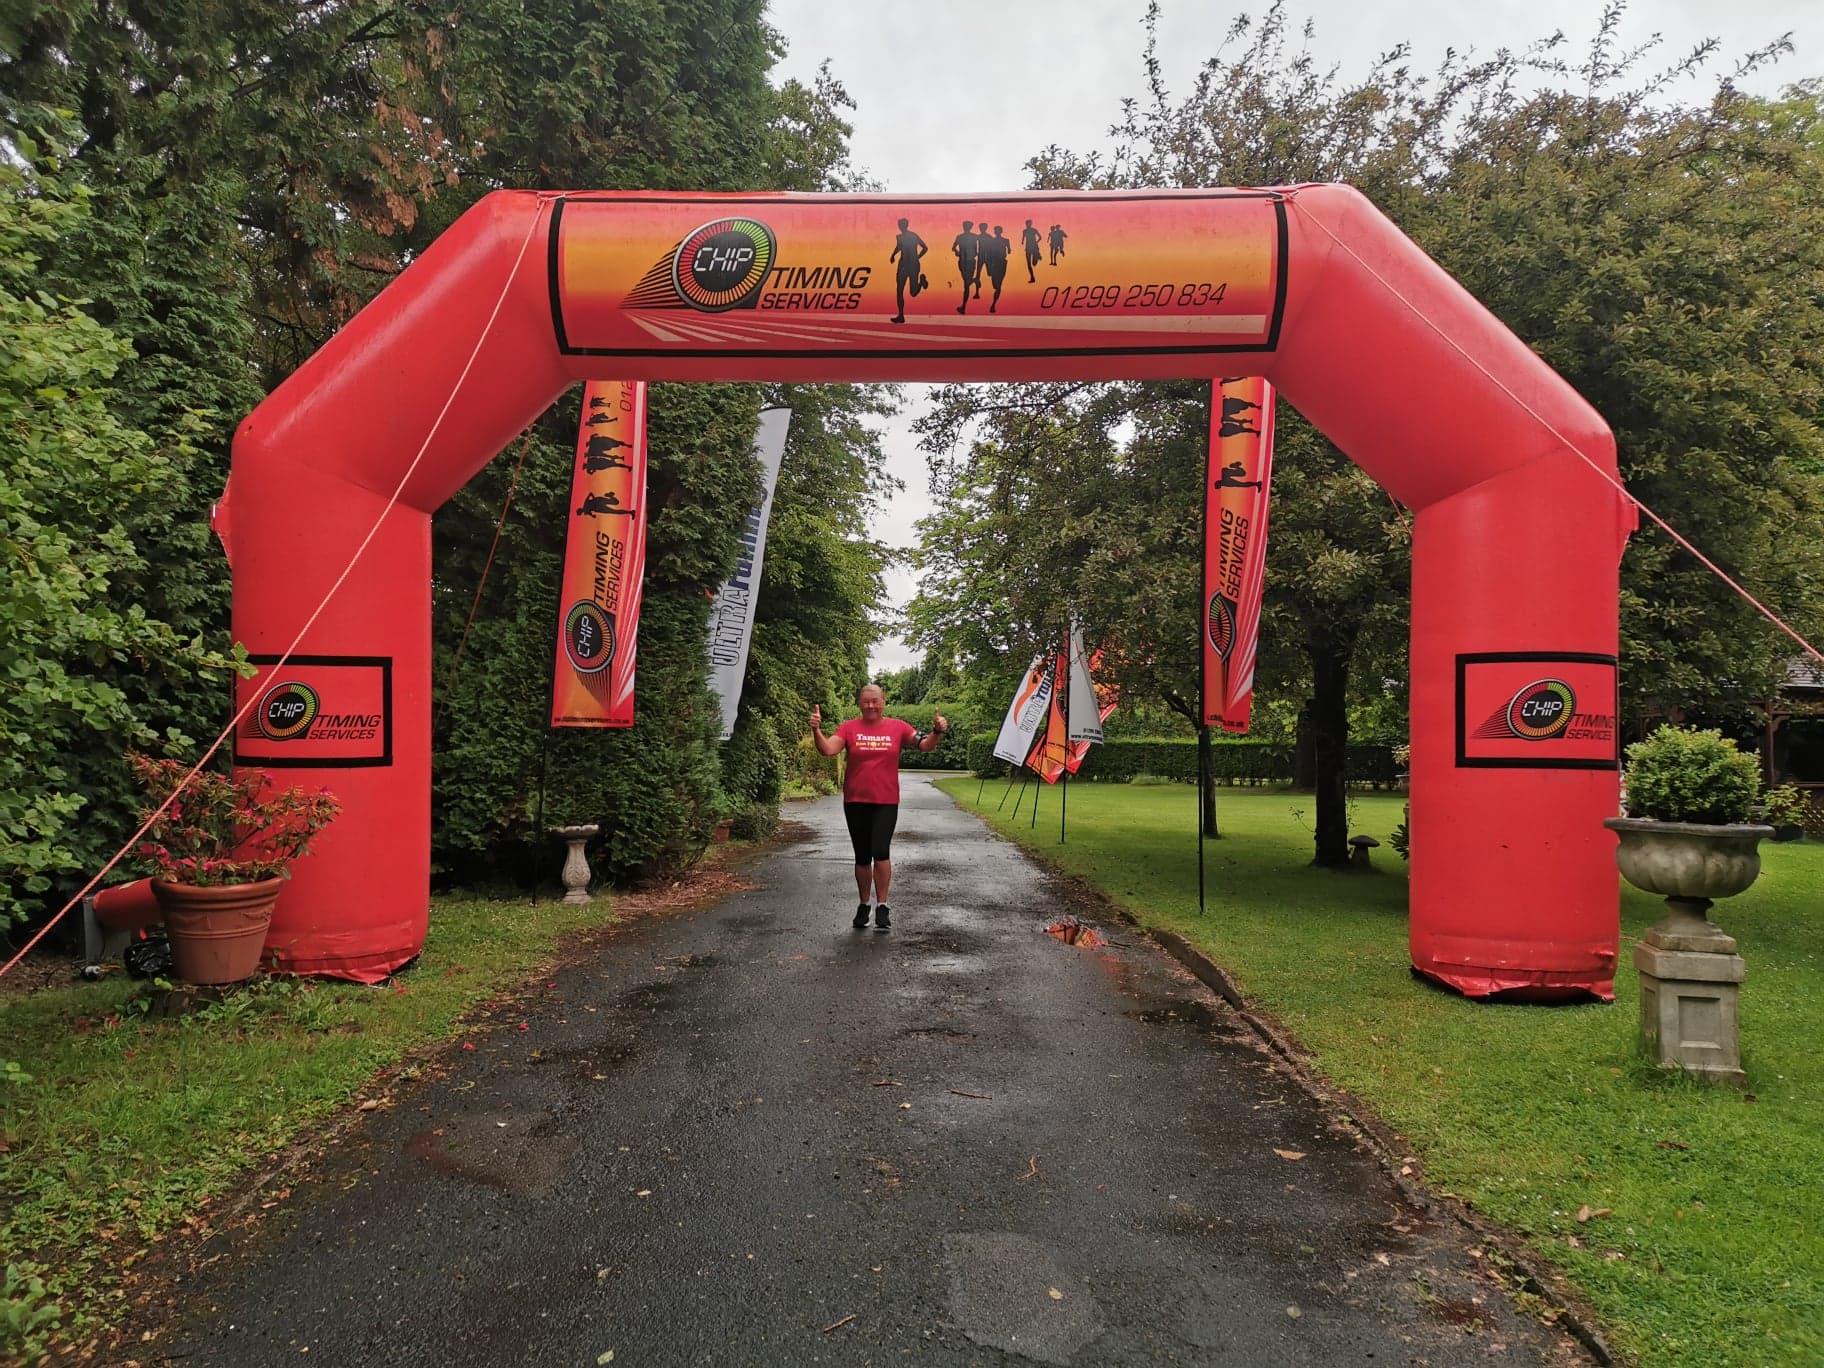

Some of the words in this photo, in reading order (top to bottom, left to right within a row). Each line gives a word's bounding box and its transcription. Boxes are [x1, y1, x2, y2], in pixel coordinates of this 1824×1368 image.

[694, 248, 754, 272] CHIP
[771, 267, 871, 289] TIMING
[761, 293, 861, 310] SERVICES
[1041, 286, 1121, 309] 01299
[1123, 284, 1175, 308] 250
[1177, 283, 1228, 306] 834
[593, 531, 610, 603] TIMING
[1226, 516, 1249, 599] SERVICES
[606, 539, 624, 611] SERVICES
[577, 615, 593, 657] CHIP
[269, 702, 305, 718] CHIP
[1522, 701, 1563, 717] CHIP
[316, 714, 382, 728] TIMING
[309, 729, 376, 740] SERVICES
